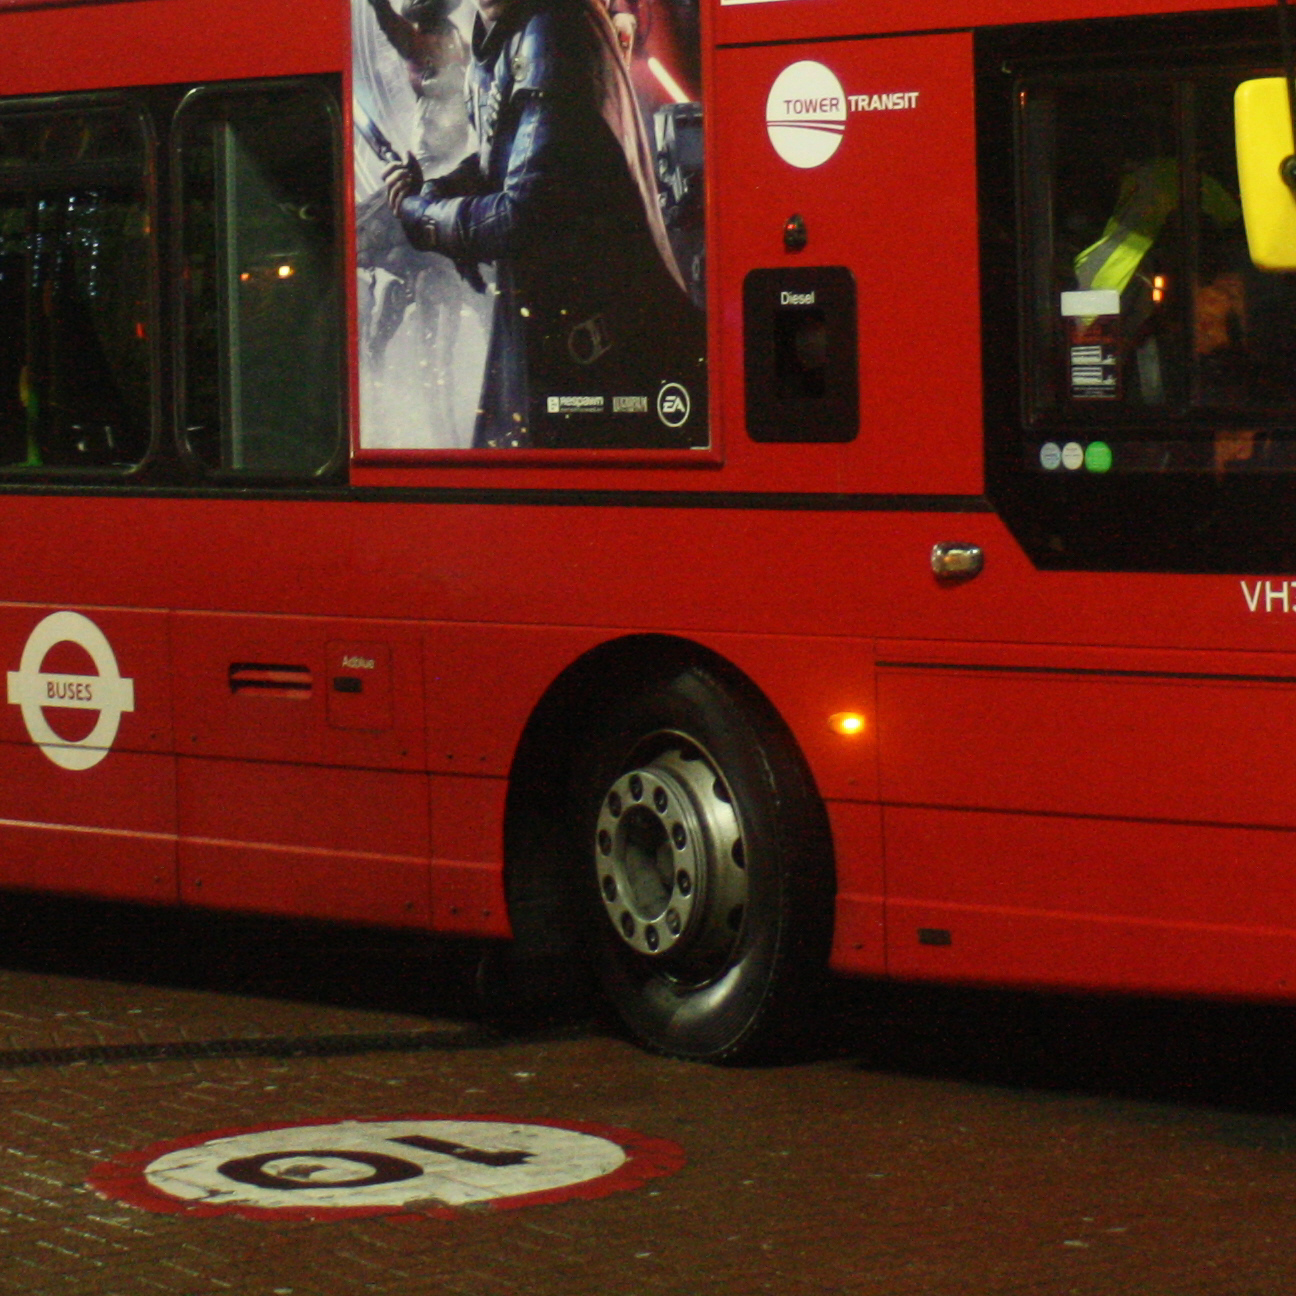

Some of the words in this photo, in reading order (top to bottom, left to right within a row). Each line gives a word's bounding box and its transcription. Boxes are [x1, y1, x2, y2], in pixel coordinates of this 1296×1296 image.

[782, 96, 841, 115] TOWER
[847, 91, 920, 112] TRANSIT
[780, 290, 816, 305] Diesel
[662, 395, 686, 413] EA
[46, 680, 93, 703] BUSES
